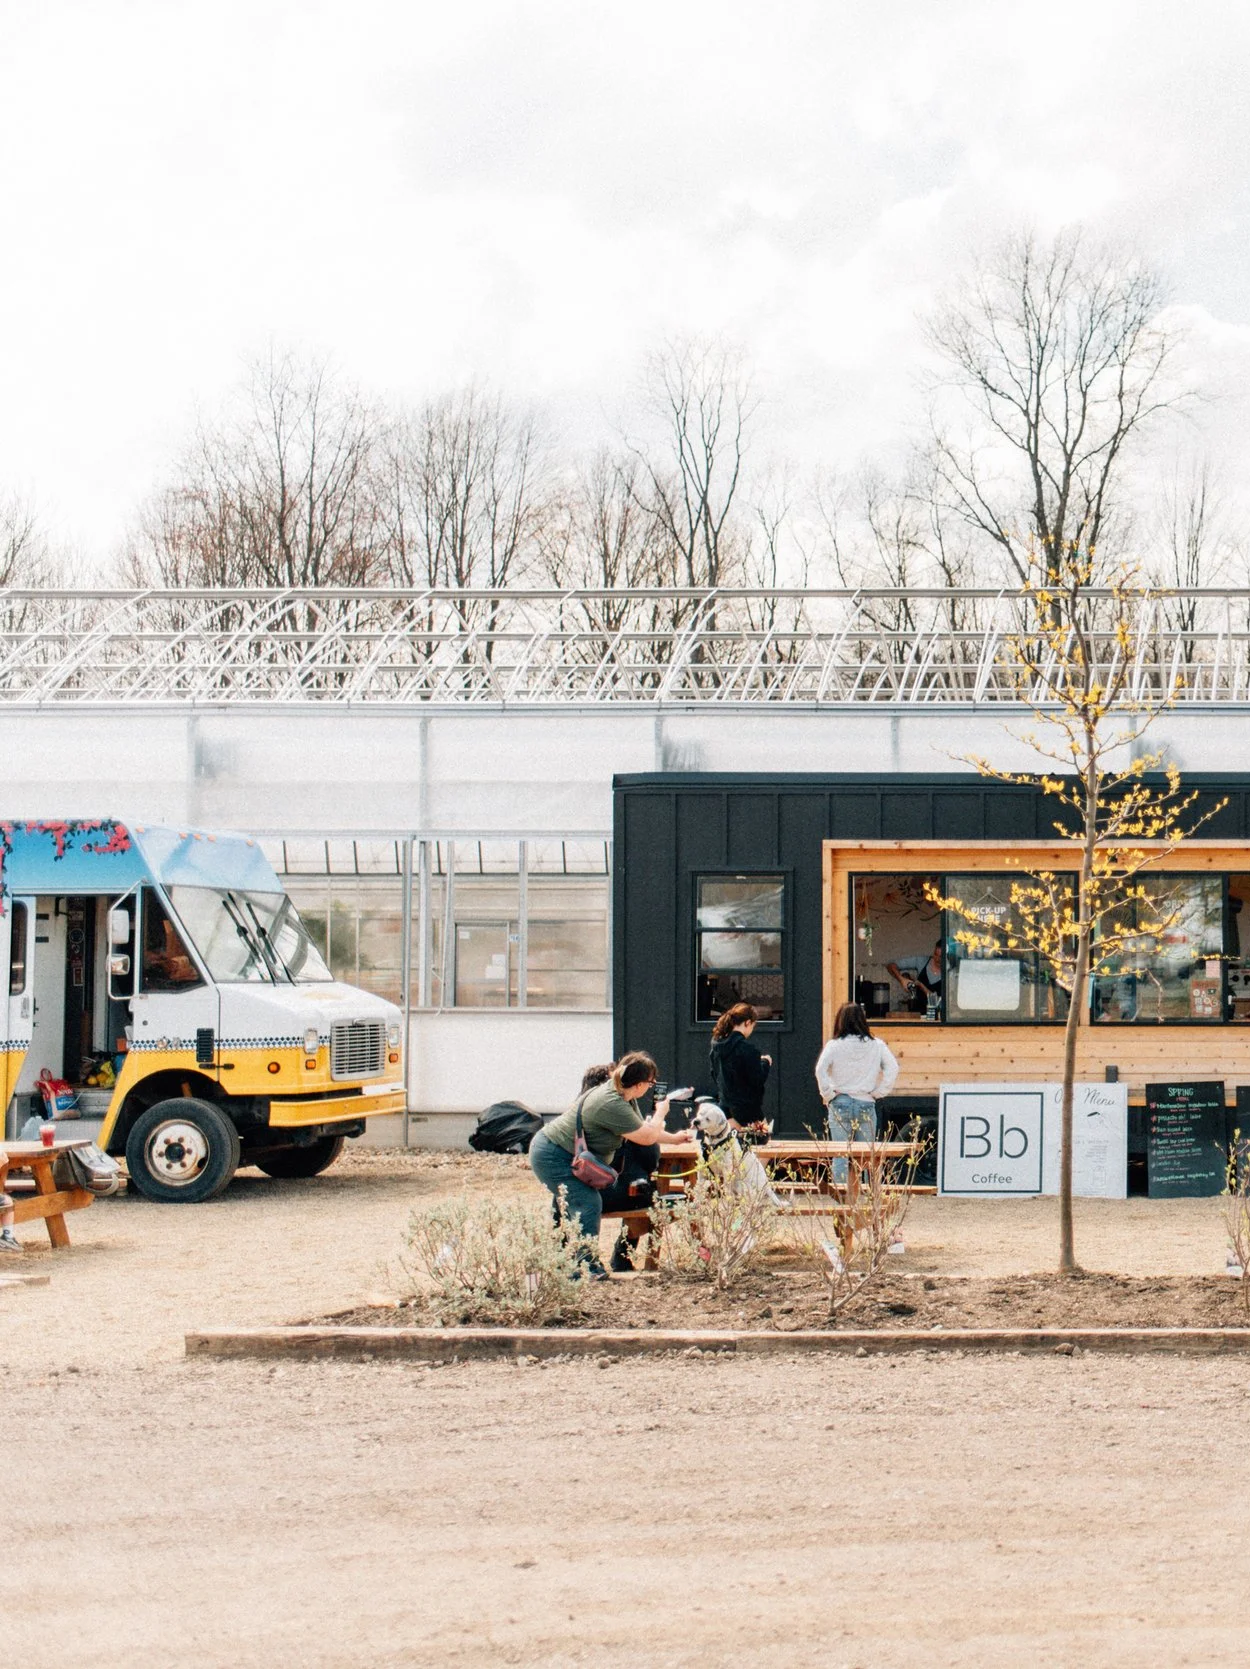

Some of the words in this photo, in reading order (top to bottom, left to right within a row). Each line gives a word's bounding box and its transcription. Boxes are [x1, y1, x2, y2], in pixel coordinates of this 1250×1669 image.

[970, 906, 1007, 915] PICK-UP
[977, 914, 1001, 922] HEE
[1083, 1087, 1116, 1106] Menu
[1168, 1087, 1194, 1097] SPRING
[959, 1113, 1029, 1159] Bb
[971, 1173, 1013, 1184] Coffee
